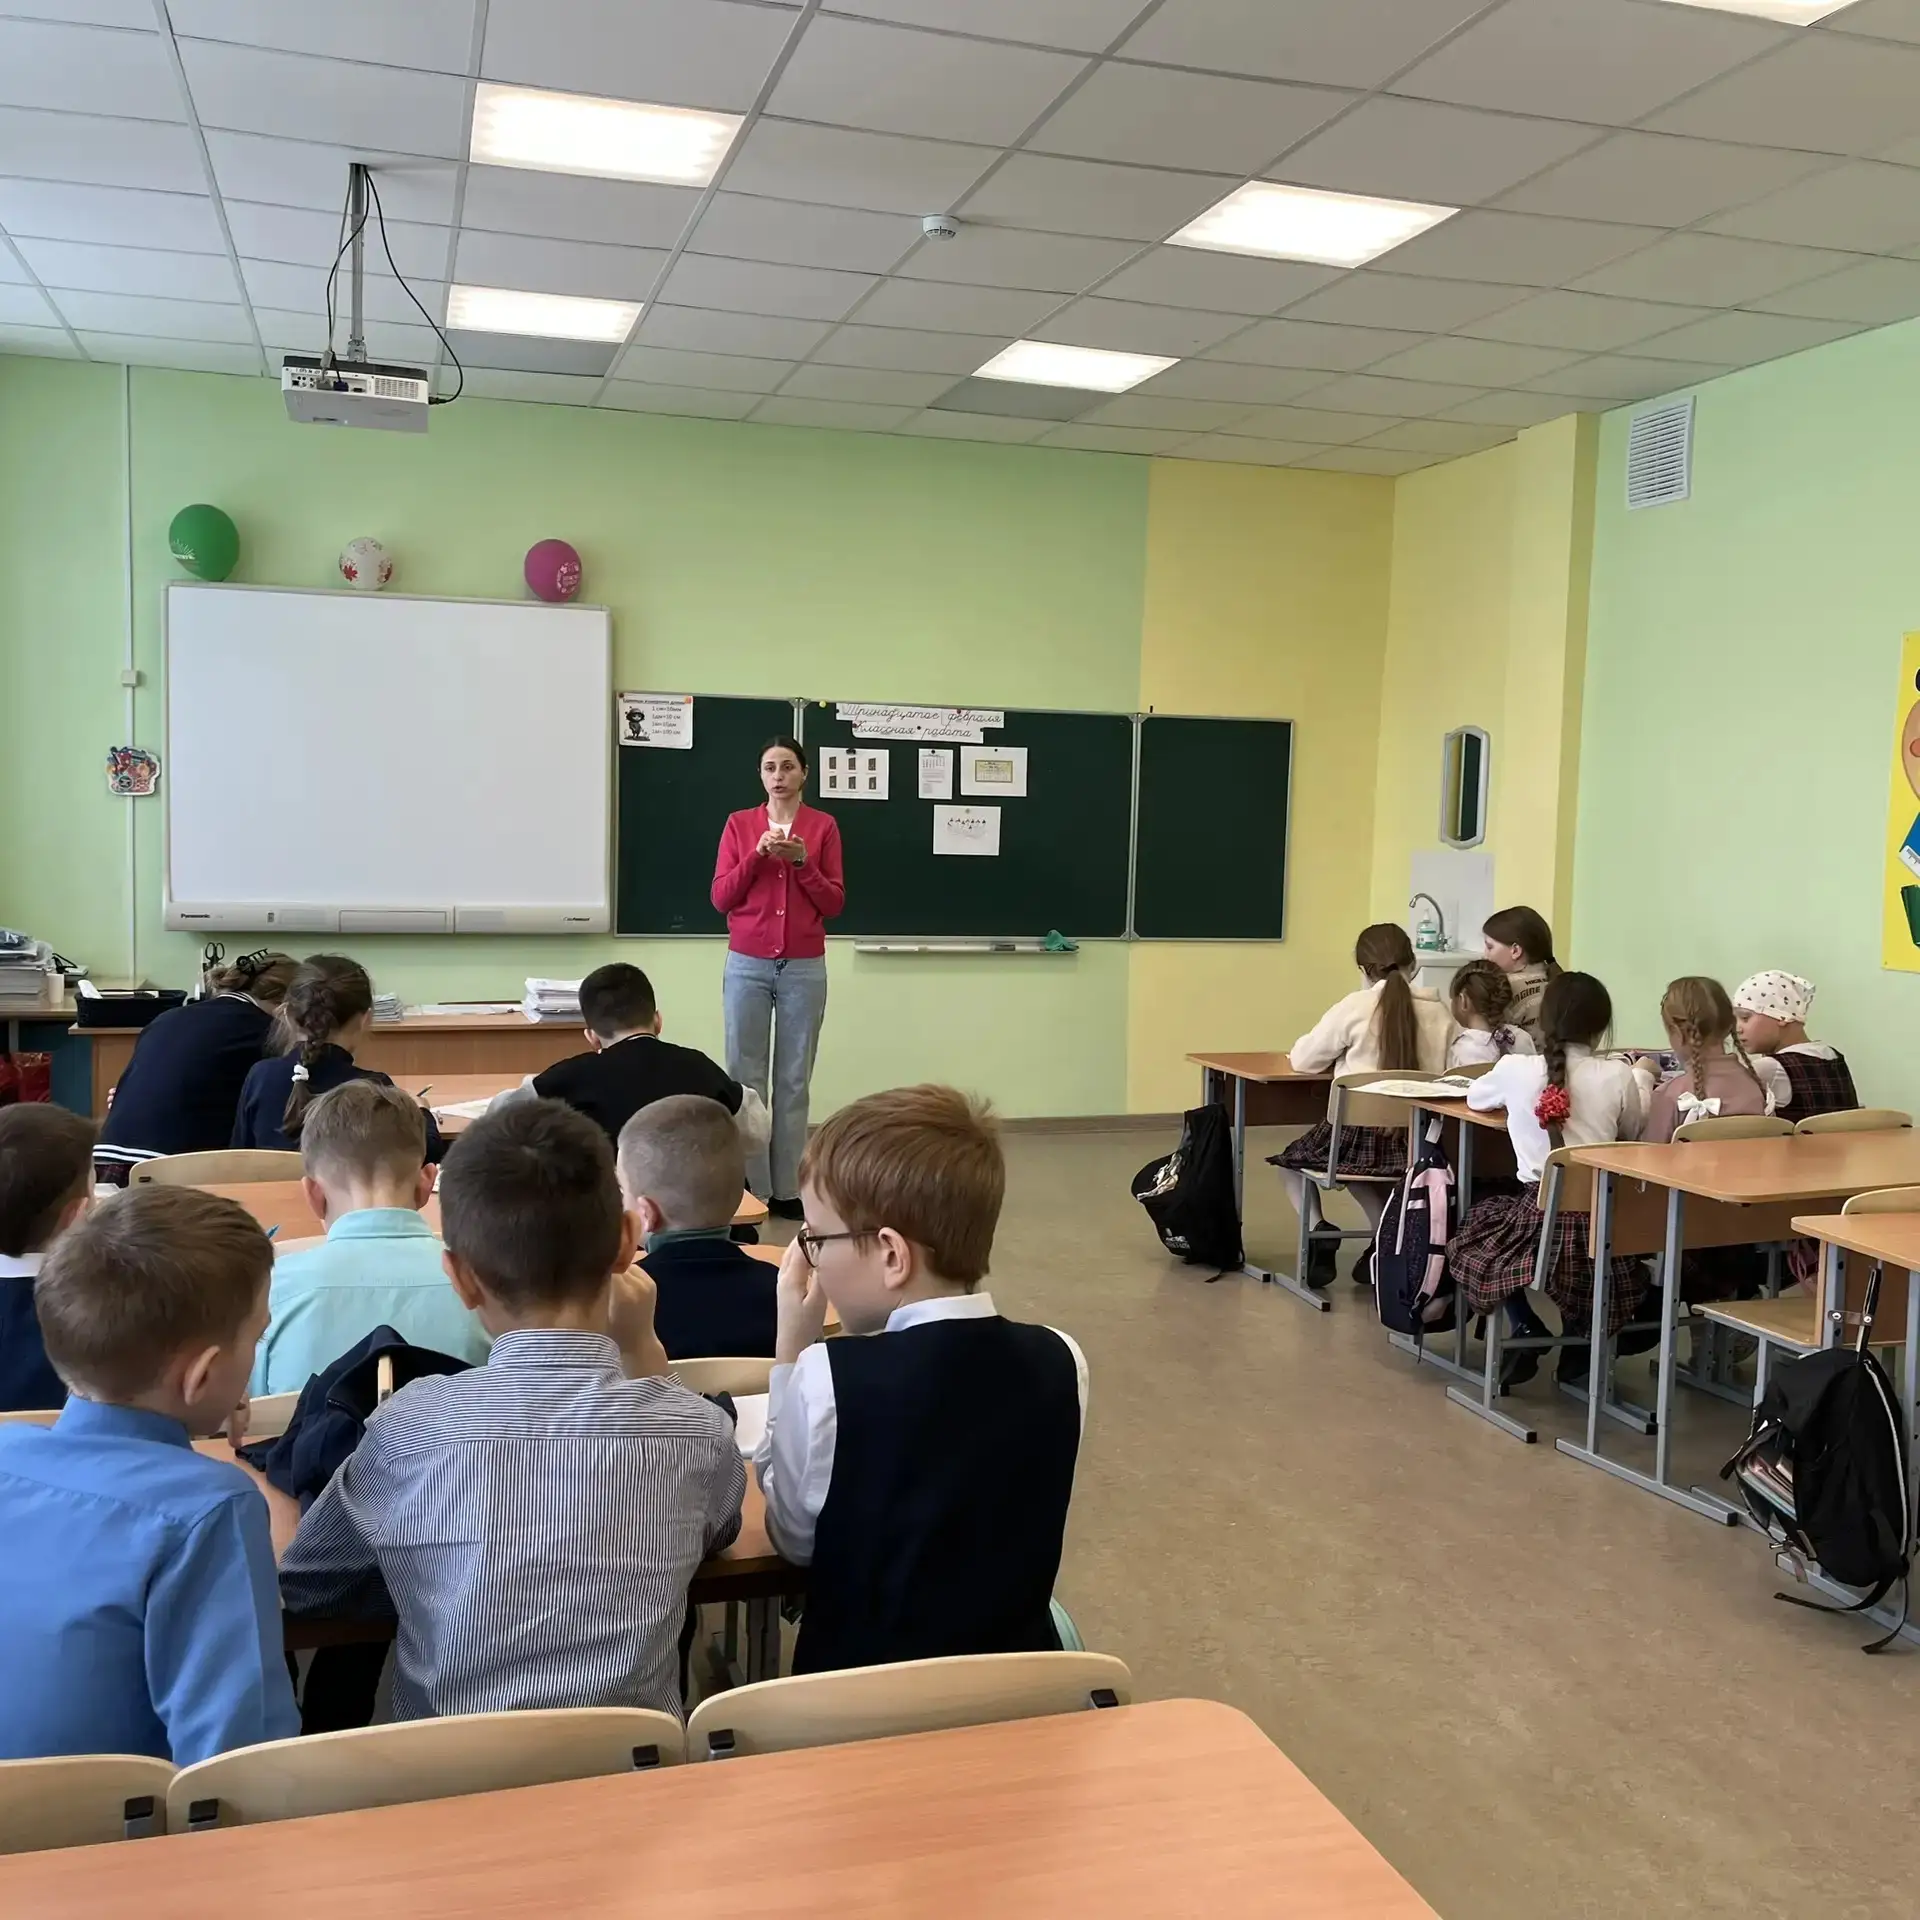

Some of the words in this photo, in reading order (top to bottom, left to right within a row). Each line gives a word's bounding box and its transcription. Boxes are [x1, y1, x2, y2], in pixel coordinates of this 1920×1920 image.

[843, 704, 941, 724] Тринадцатое
[945, 709, 1002, 727] февраля
[856, 720, 917, 735] Классная
[921, 724, 972, 740] работа
[1511, 986, 1541, 1004] NGINE
